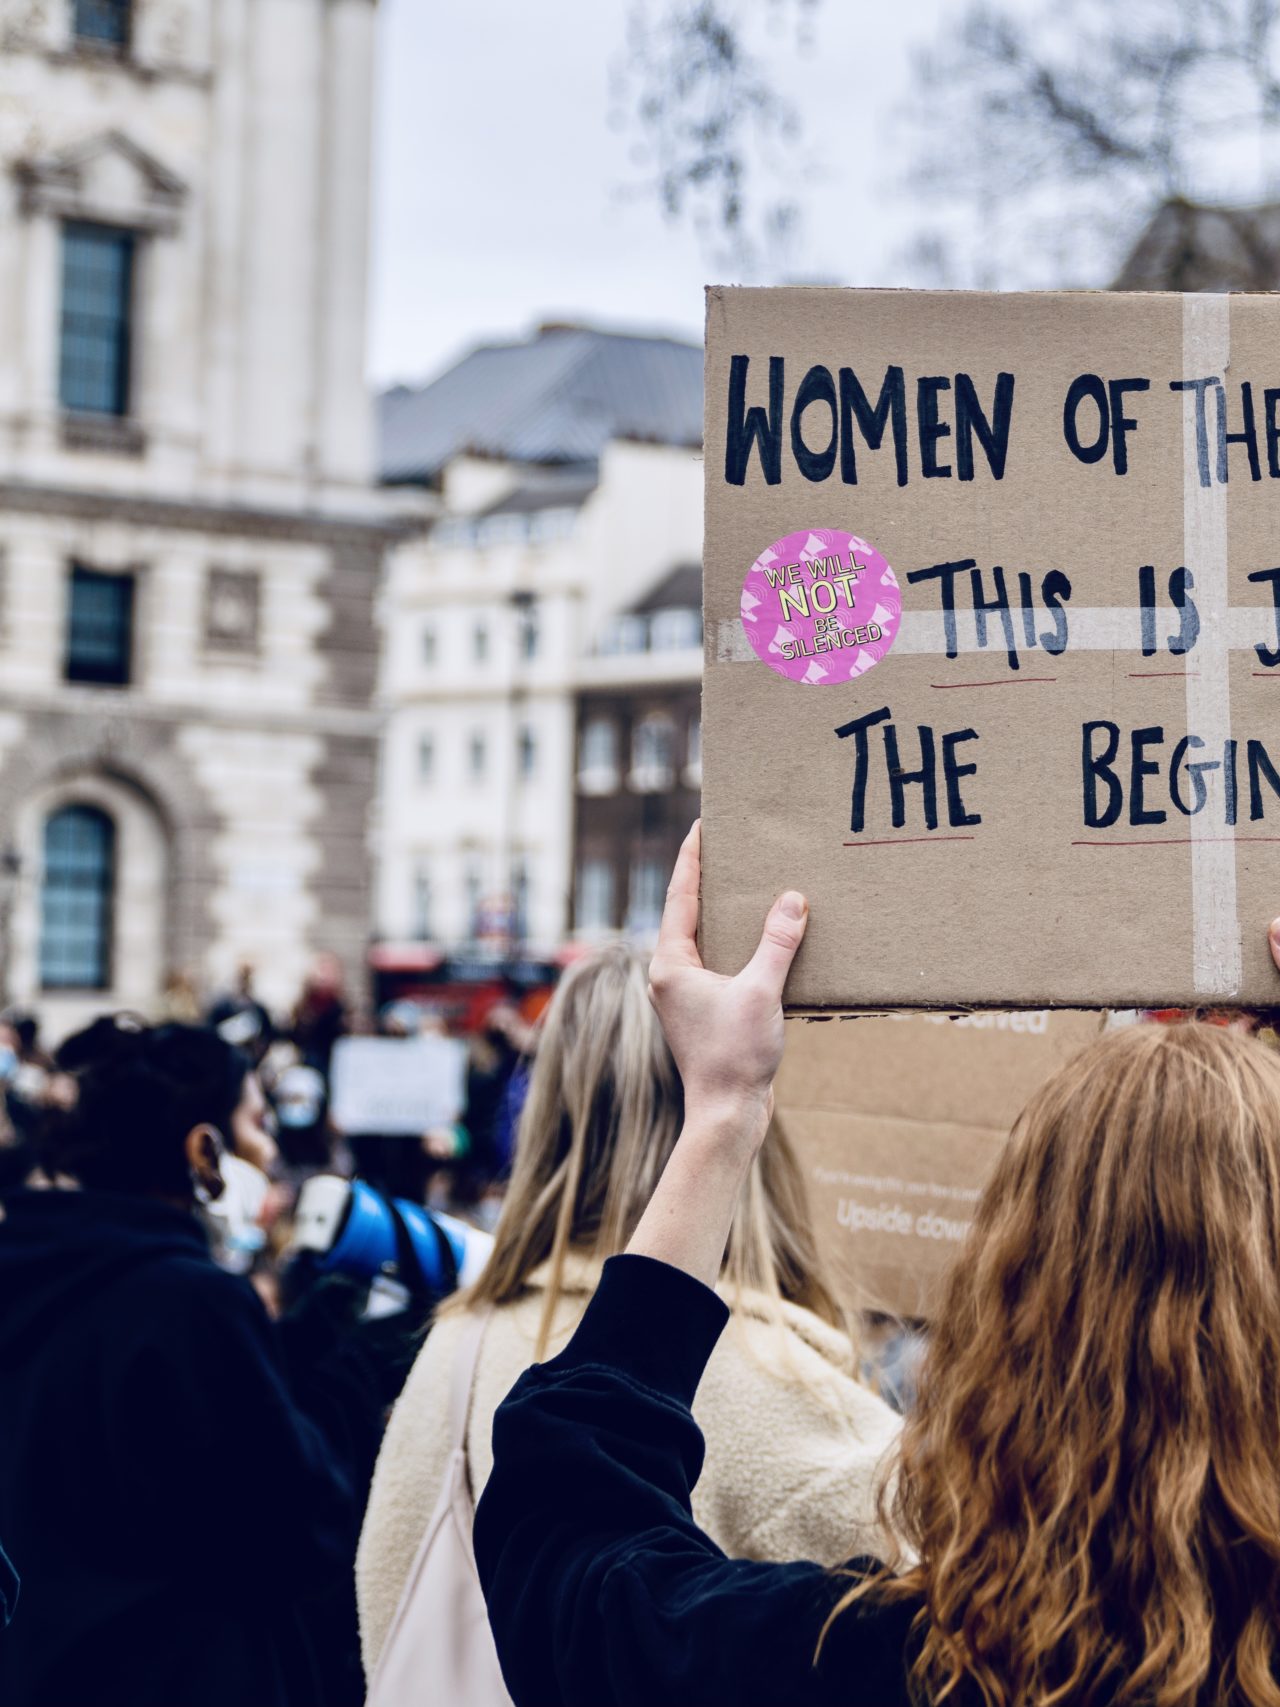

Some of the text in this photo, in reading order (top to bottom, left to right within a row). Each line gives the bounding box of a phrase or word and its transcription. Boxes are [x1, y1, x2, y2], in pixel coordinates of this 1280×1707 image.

[725, 355, 1015, 488] WOMEN
[1063, 373, 1151, 476] OF
[764, 552, 866, 588] WE WILL
[778, 573, 858, 621] NOT
[907, 558, 1072, 671] THIS
[1138, 565, 1201, 657] IS
[781, 623, 882, 660] SILENCED
[814, 616, 840, 634] BE
[834, 706, 982, 833] THE
[836, 1198, 913, 1235] Upside
